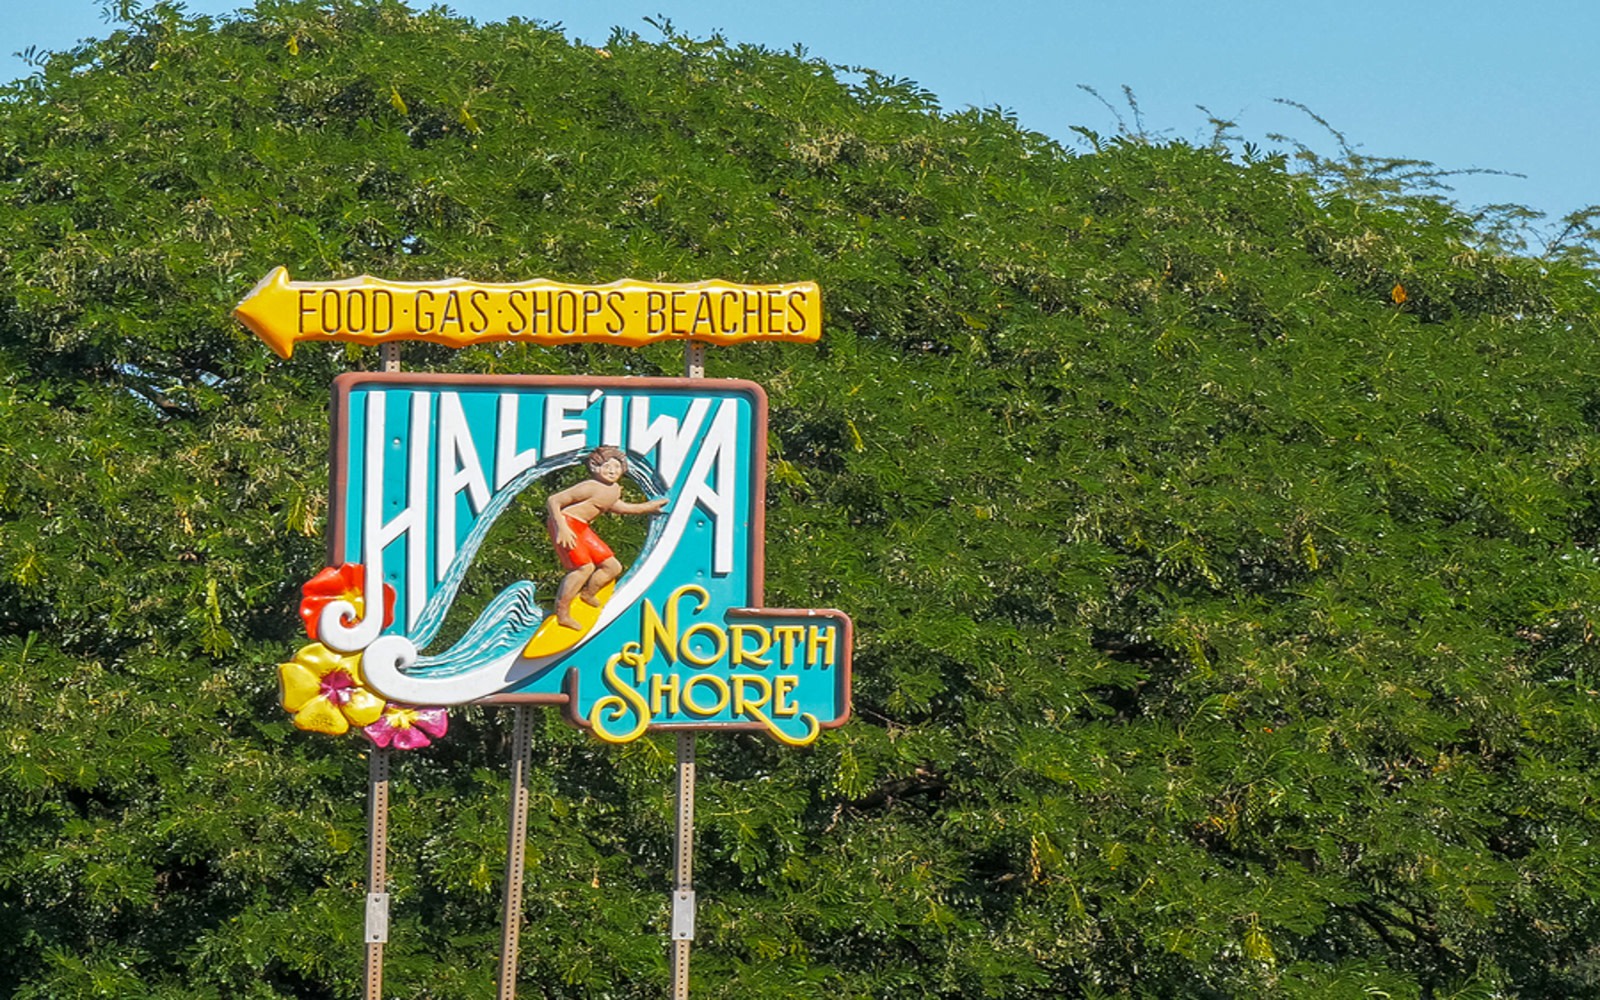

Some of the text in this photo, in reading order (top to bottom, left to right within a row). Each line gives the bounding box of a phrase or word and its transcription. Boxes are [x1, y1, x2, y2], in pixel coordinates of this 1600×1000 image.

[298, 290, 808, 336] FOOD GAS SHOPS BEACHES
[621, 584, 837, 666] NORTH
[590, 648, 821, 746] SHORE
